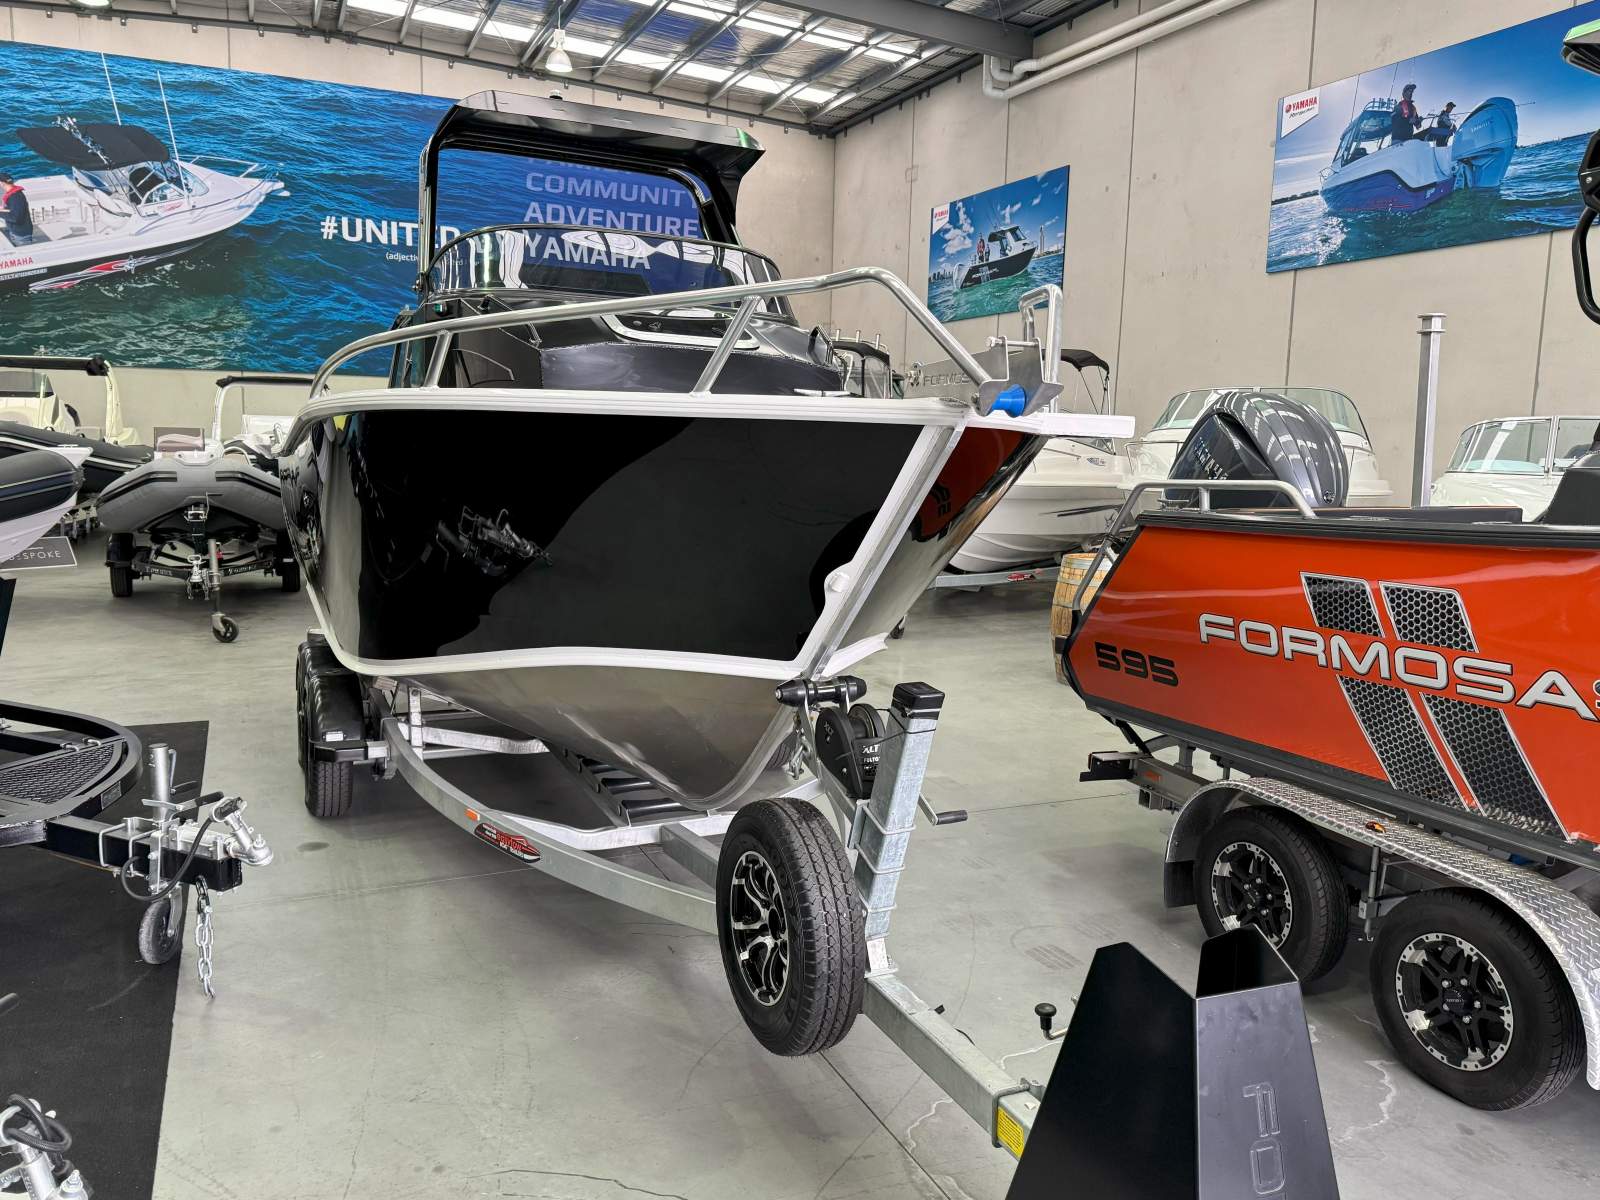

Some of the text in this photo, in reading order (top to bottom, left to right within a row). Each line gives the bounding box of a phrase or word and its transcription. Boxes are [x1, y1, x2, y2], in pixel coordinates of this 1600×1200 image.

[1292, 97, 1318, 111] YAMAHA
[320, 215, 461, 251] #UNITD
[522, 229, 651, 270] YAMAHA
[923, 372, 971, 387] FORMOS
[1094, 641, 1180, 688] 595
[1198, 612, 1600, 722] FORMOSA
